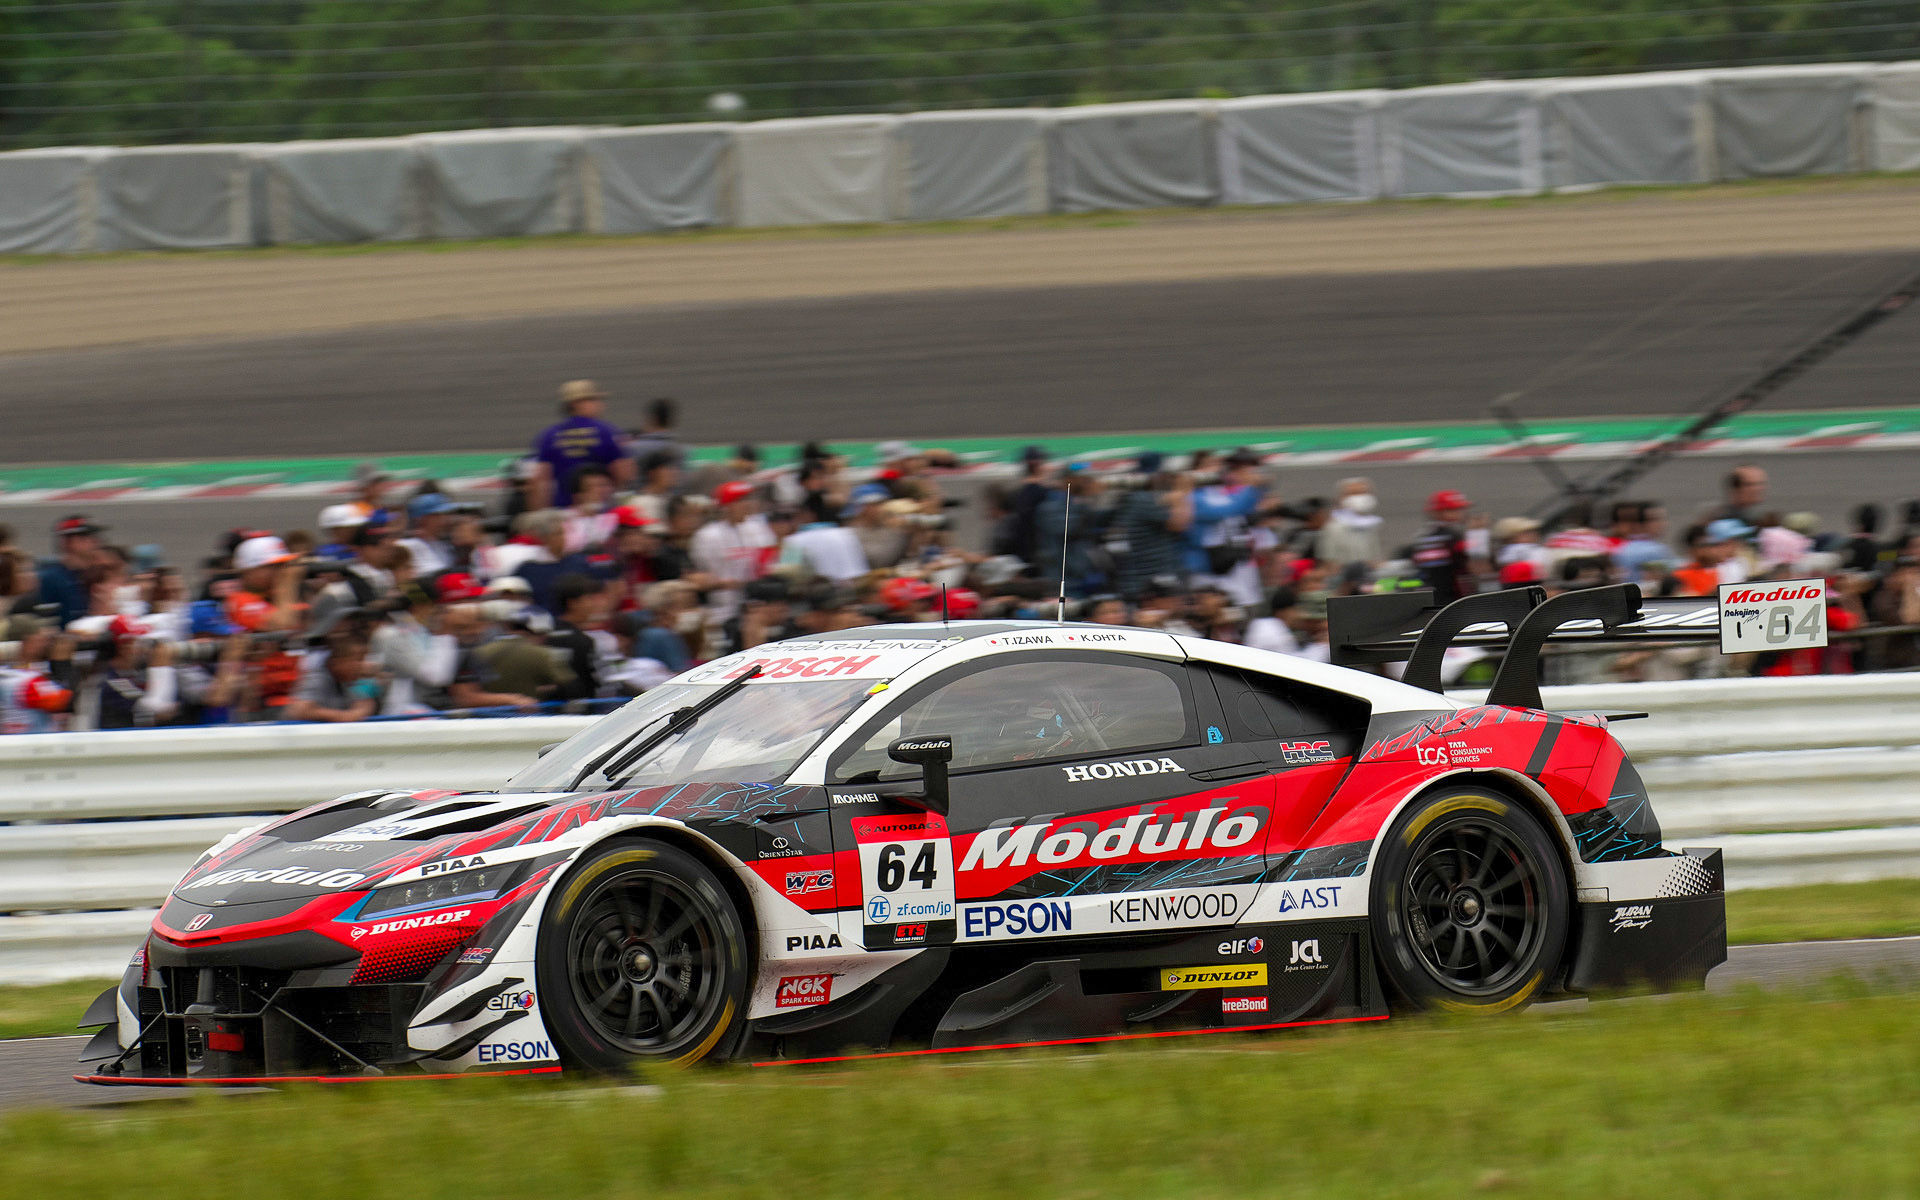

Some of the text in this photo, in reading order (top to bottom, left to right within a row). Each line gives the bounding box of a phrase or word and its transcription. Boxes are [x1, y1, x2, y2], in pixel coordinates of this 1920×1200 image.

[1725, 585, 1821, 604] Modulo
[1766, 603, 1821, 643] 64
[826, 642, 939, 651] RACING
[1002, 635, 1053, 645] T.IZAWA
[1080, 634, 1126, 642] K.OHTA
[721, 655, 881, 680] BOSCH
[897, 741, 951, 751] Modulo
[1280, 740, 1334, 760] HRC
[1450, 747, 1493, 756] CONSULTANCY
[1452, 755, 1480, 764] SERVICES
[1062, 758, 1185, 782] HONDA
[873, 822, 942, 833] AUTOBACS
[958, 806, 1259, 872] Modulo
[421, 856, 486, 876] PIAA
[877, 841, 938, 893] 64
[181, 866, 366, 890] Modulo
[1301, 886, 1342, 909] AST
[869, 901, 889, 919] ZF
[897, 901, 952, 916] zf.com/jp
[1109, 893, 1238, 924] KENWOOD
[1609, 905, 1653, 922] JURAN
[369, 910, 471, 935] DUNLOP
[965, 901, 1072, 938] EPSON
[897, 924, 926, 938] ETS
[787, 934, 843, 951] PIAA
[1217, 940, 1246, 955] elf
[1290, 939, 1322, 964] JCL
[1183, 971, 1258, 983] DUNLOP
[1284, 965, 1299, 973] Japan
[781, 977, 828, 996] NGK
[487, 993, 519, 1010] elf
[781, 997, 803, 1005] SPARK
[1222, 998, 1267, 1011] hreeBond
[478, 1041, 549, 1062] EPSON
